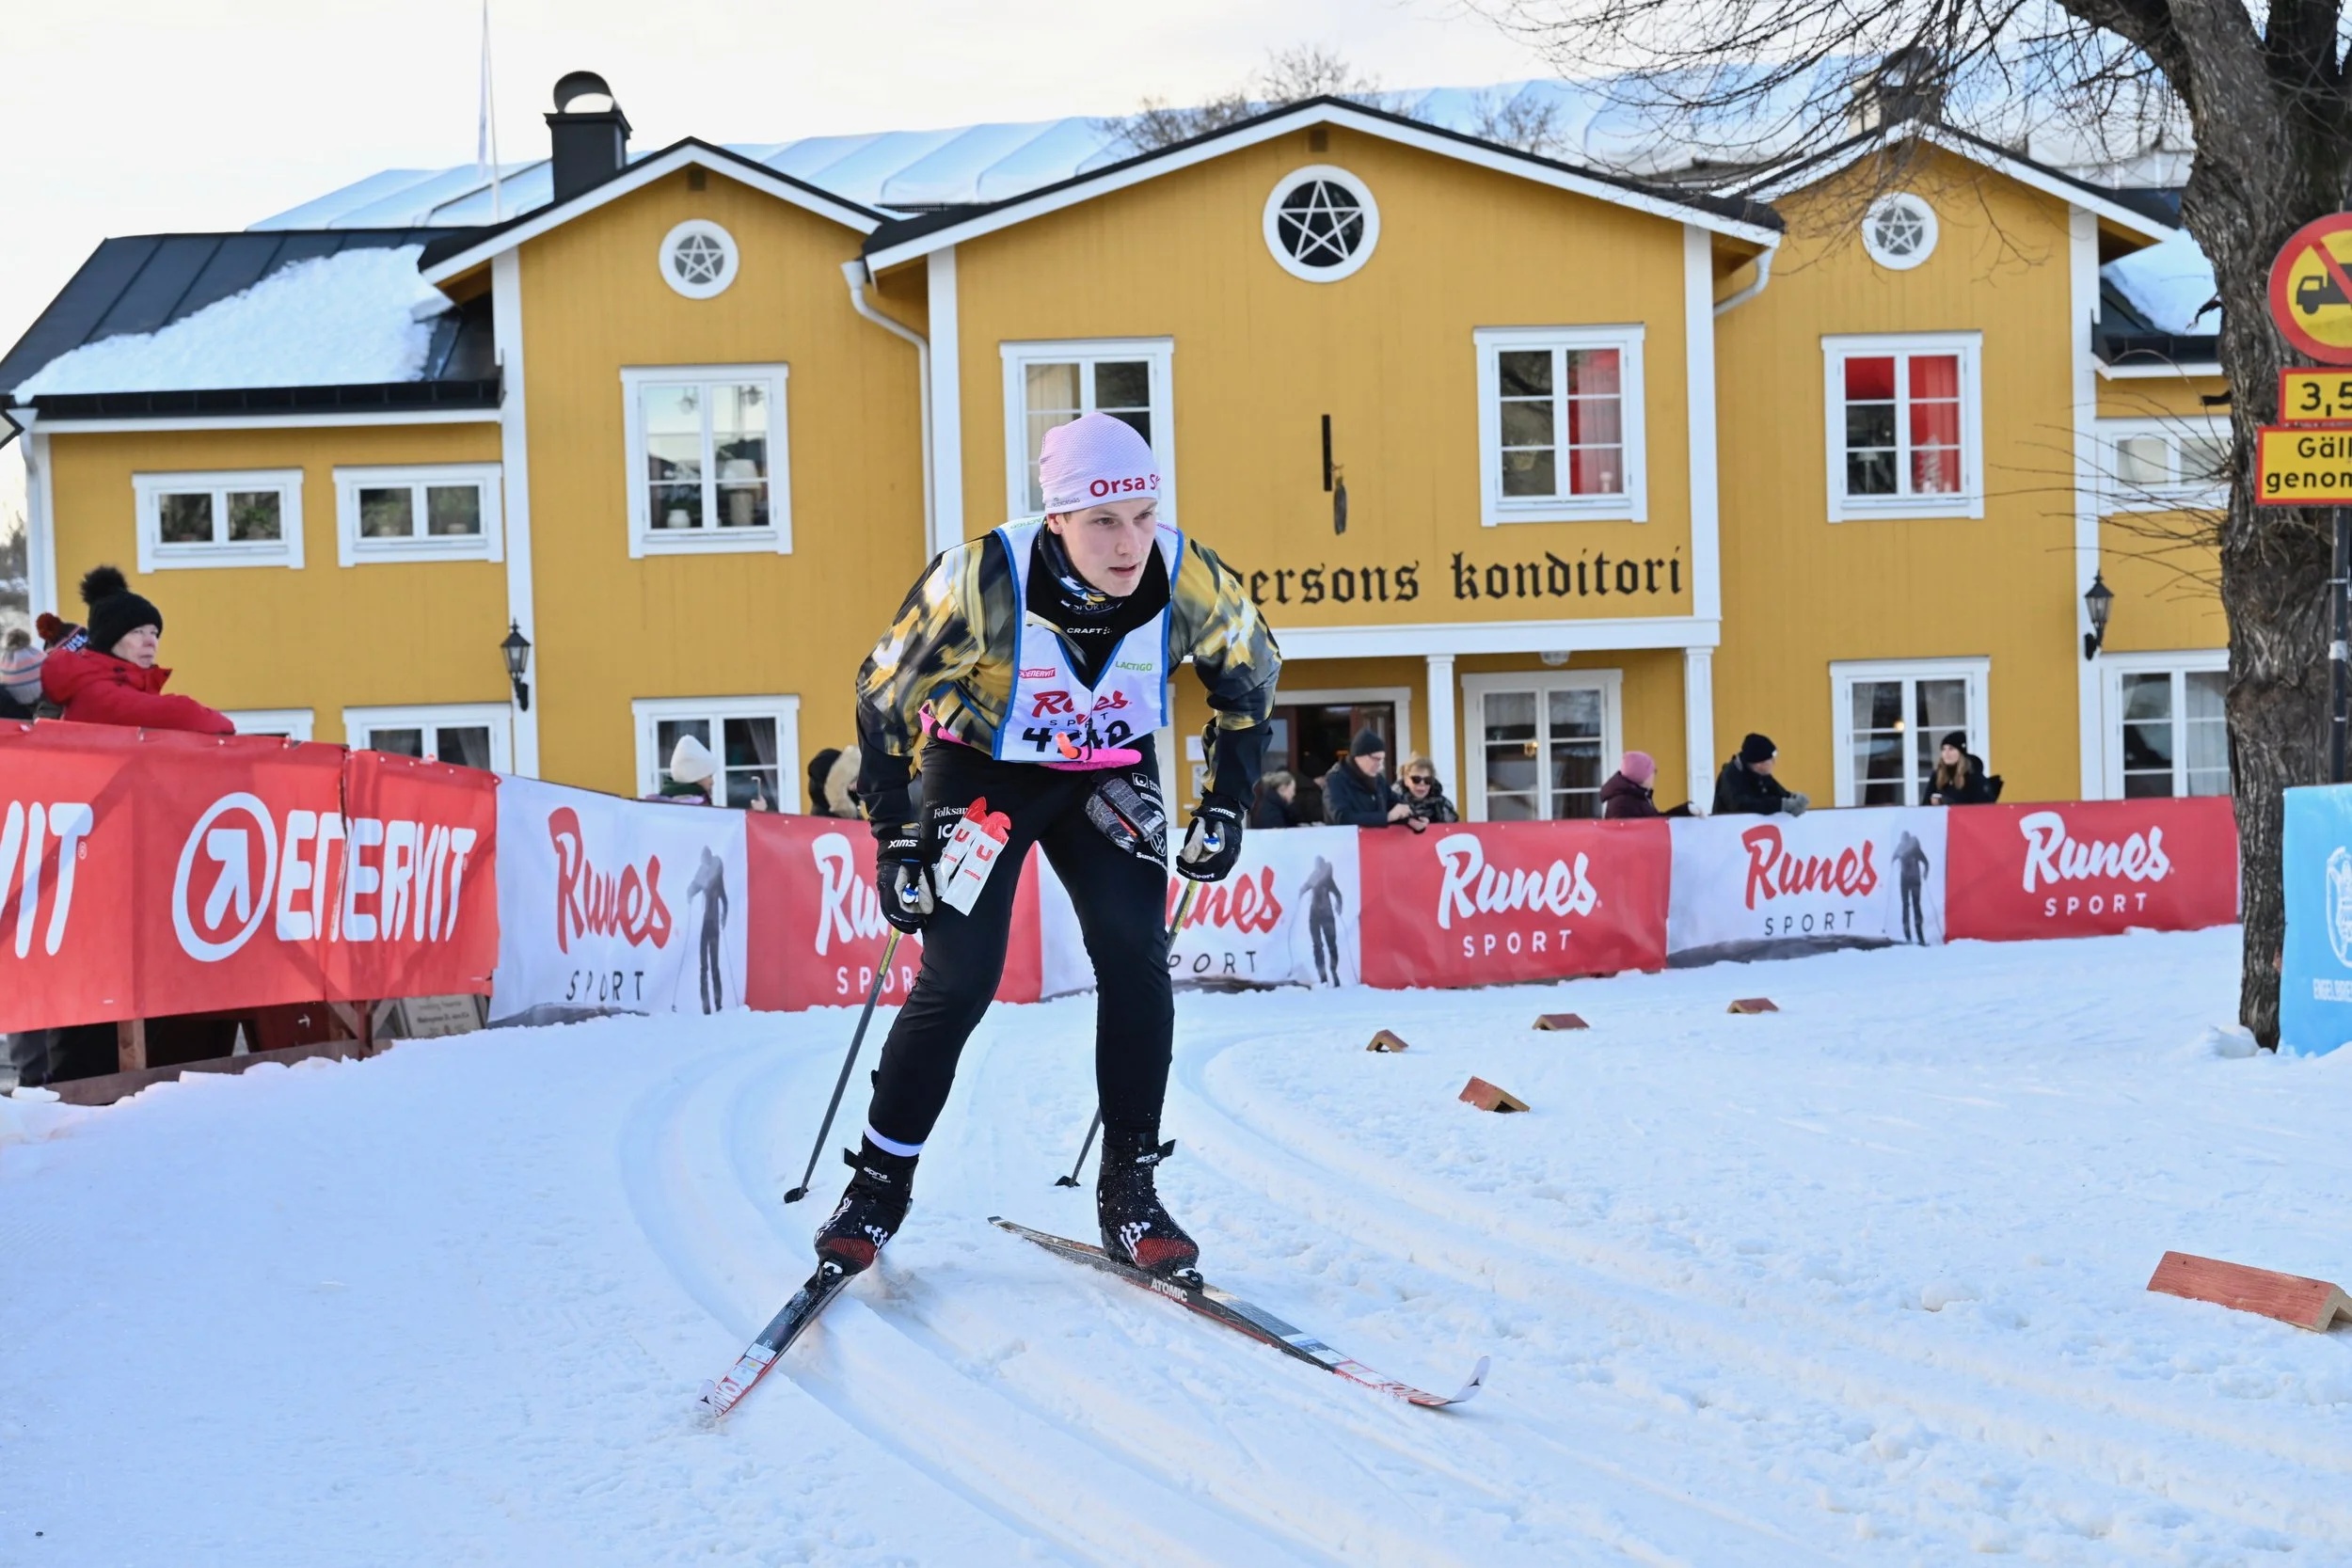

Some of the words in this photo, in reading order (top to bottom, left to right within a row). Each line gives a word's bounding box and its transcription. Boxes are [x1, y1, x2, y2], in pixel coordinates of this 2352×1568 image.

[2300, 382, 2352, 417] 3,5
[1089, 476, 1146, 498] Orsa
[1236, 561, 1420, 605] ersons
[1451, 546, 1682, 600] konditori
[1115, 660, 1152, 672] LACTIGO
[938, 824, 953, 839] IC
[2019, 811, 2170, 893] Runes
[276, 809, 477, 942] ENERVIT
[548, 806, 672, 955] Runes
[1435, 833, 1597, 929] Runes
[1741, 824, 1878, 911] Runes
[1166, 865, 1282, 934] unes
[2044, 893, 2147, 917] SPORT
[1765, 911, 1854, 936] SPORT
[1463, 929, 1571, 958] SPORT
[1168, 951, 1256, 974] PORT
[836, 965, 914, 995] SPOR
[1151, 1280, 1188, 1303] ATOMIC
